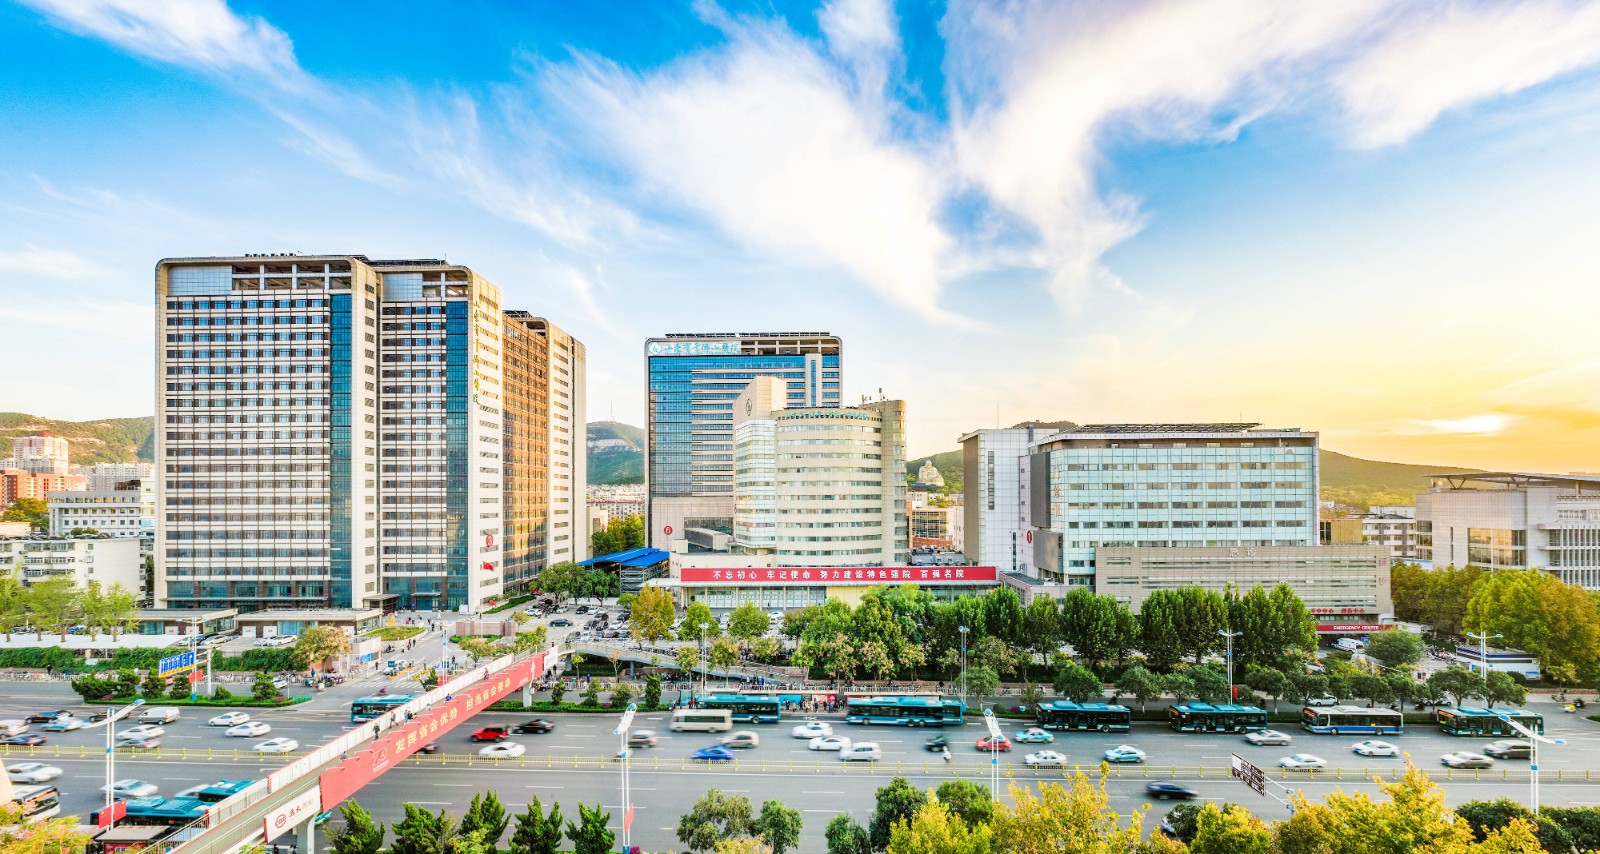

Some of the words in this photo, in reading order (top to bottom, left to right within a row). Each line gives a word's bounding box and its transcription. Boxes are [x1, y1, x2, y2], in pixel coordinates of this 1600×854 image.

[712, 569, 758, 580] 不忘初心
[767, 569, 811, 580] 牢记使命
[819, 568, 912, 580] 努力建设特色强院
[919, 568, 966, 580] 百强名院
[395, 707, 458, 754] 发挥省会优势
[465, 677, 511, 711] 担当省会使命
